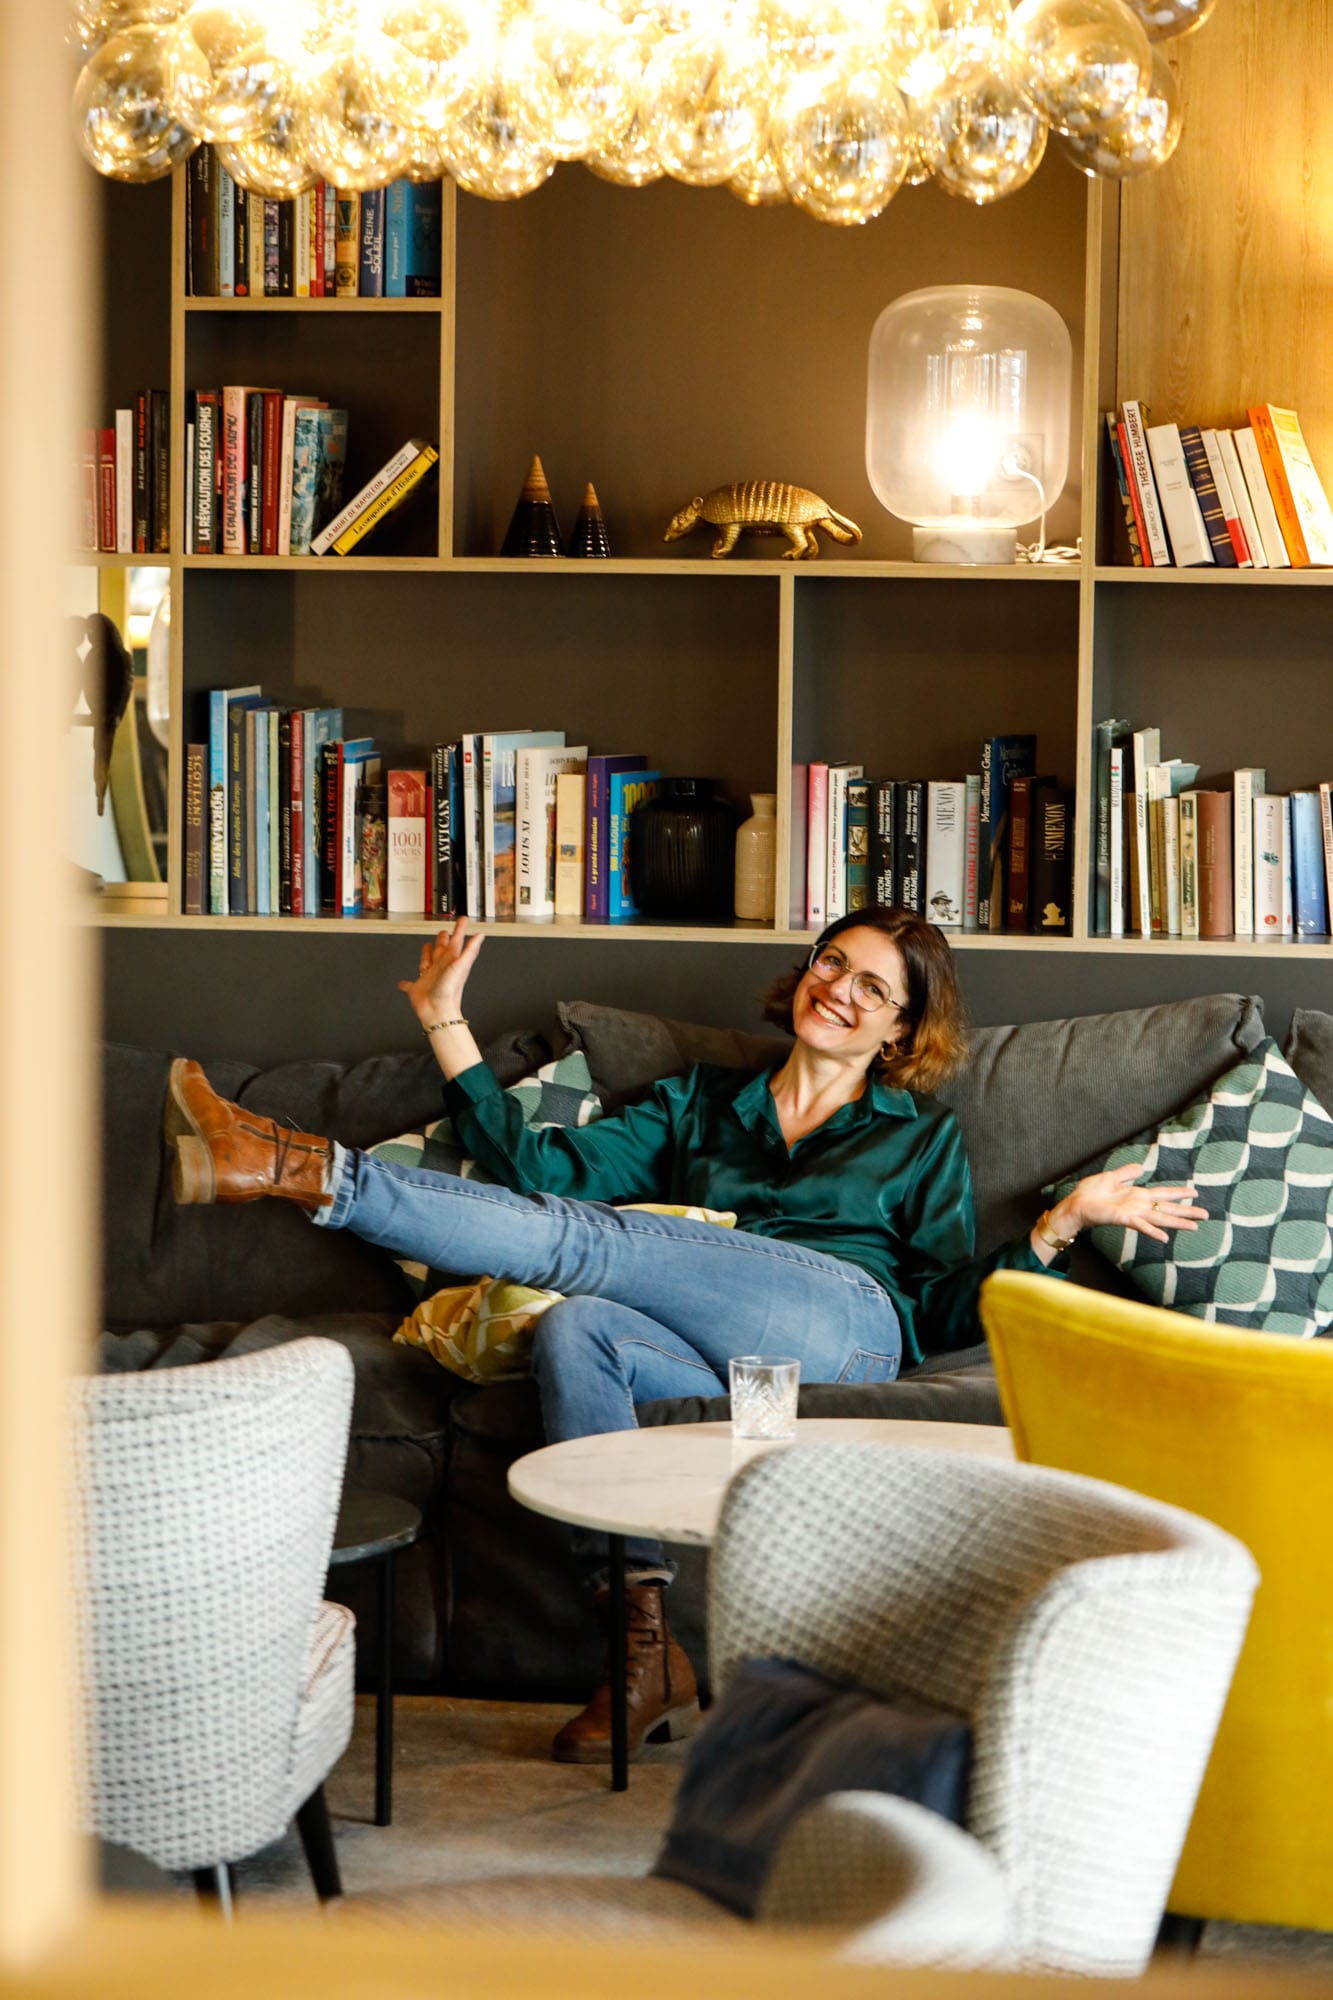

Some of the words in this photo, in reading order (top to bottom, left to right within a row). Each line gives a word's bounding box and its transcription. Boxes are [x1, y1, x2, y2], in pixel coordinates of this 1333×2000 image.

[362, 208, 374, 245] REINE
[363, 248, 374, 264] LA
[370, 233, 382, 274] SOLEIL
[200, 406, 212, 448] FOURMIS
[1127, 408, 1142, 447] HUMBERT
[199, 450, 210, 466] DES
[194, 467, 210, 527] RÉVOLUTION
[198, 528, 210, 540] LA
[980, 744, 992, 769] Grèce
[193, 755, 202, 827] SCOTLAND
[936, 786, 955, 832] SIMENON
[980, 770, 990, 823] Merveilleuse
[212, 791, 224, 877] NORMANDIE
[392, 832, 422, 848] 1001
[438, 799, 450, 864] VATICAN
[521, 818, 530, 834] XI
[610, 814, 618, 856] BLAGUES
[1044, 802, 1065, 850] SIMENON
[521, 837, 530, 874] LOUIS
